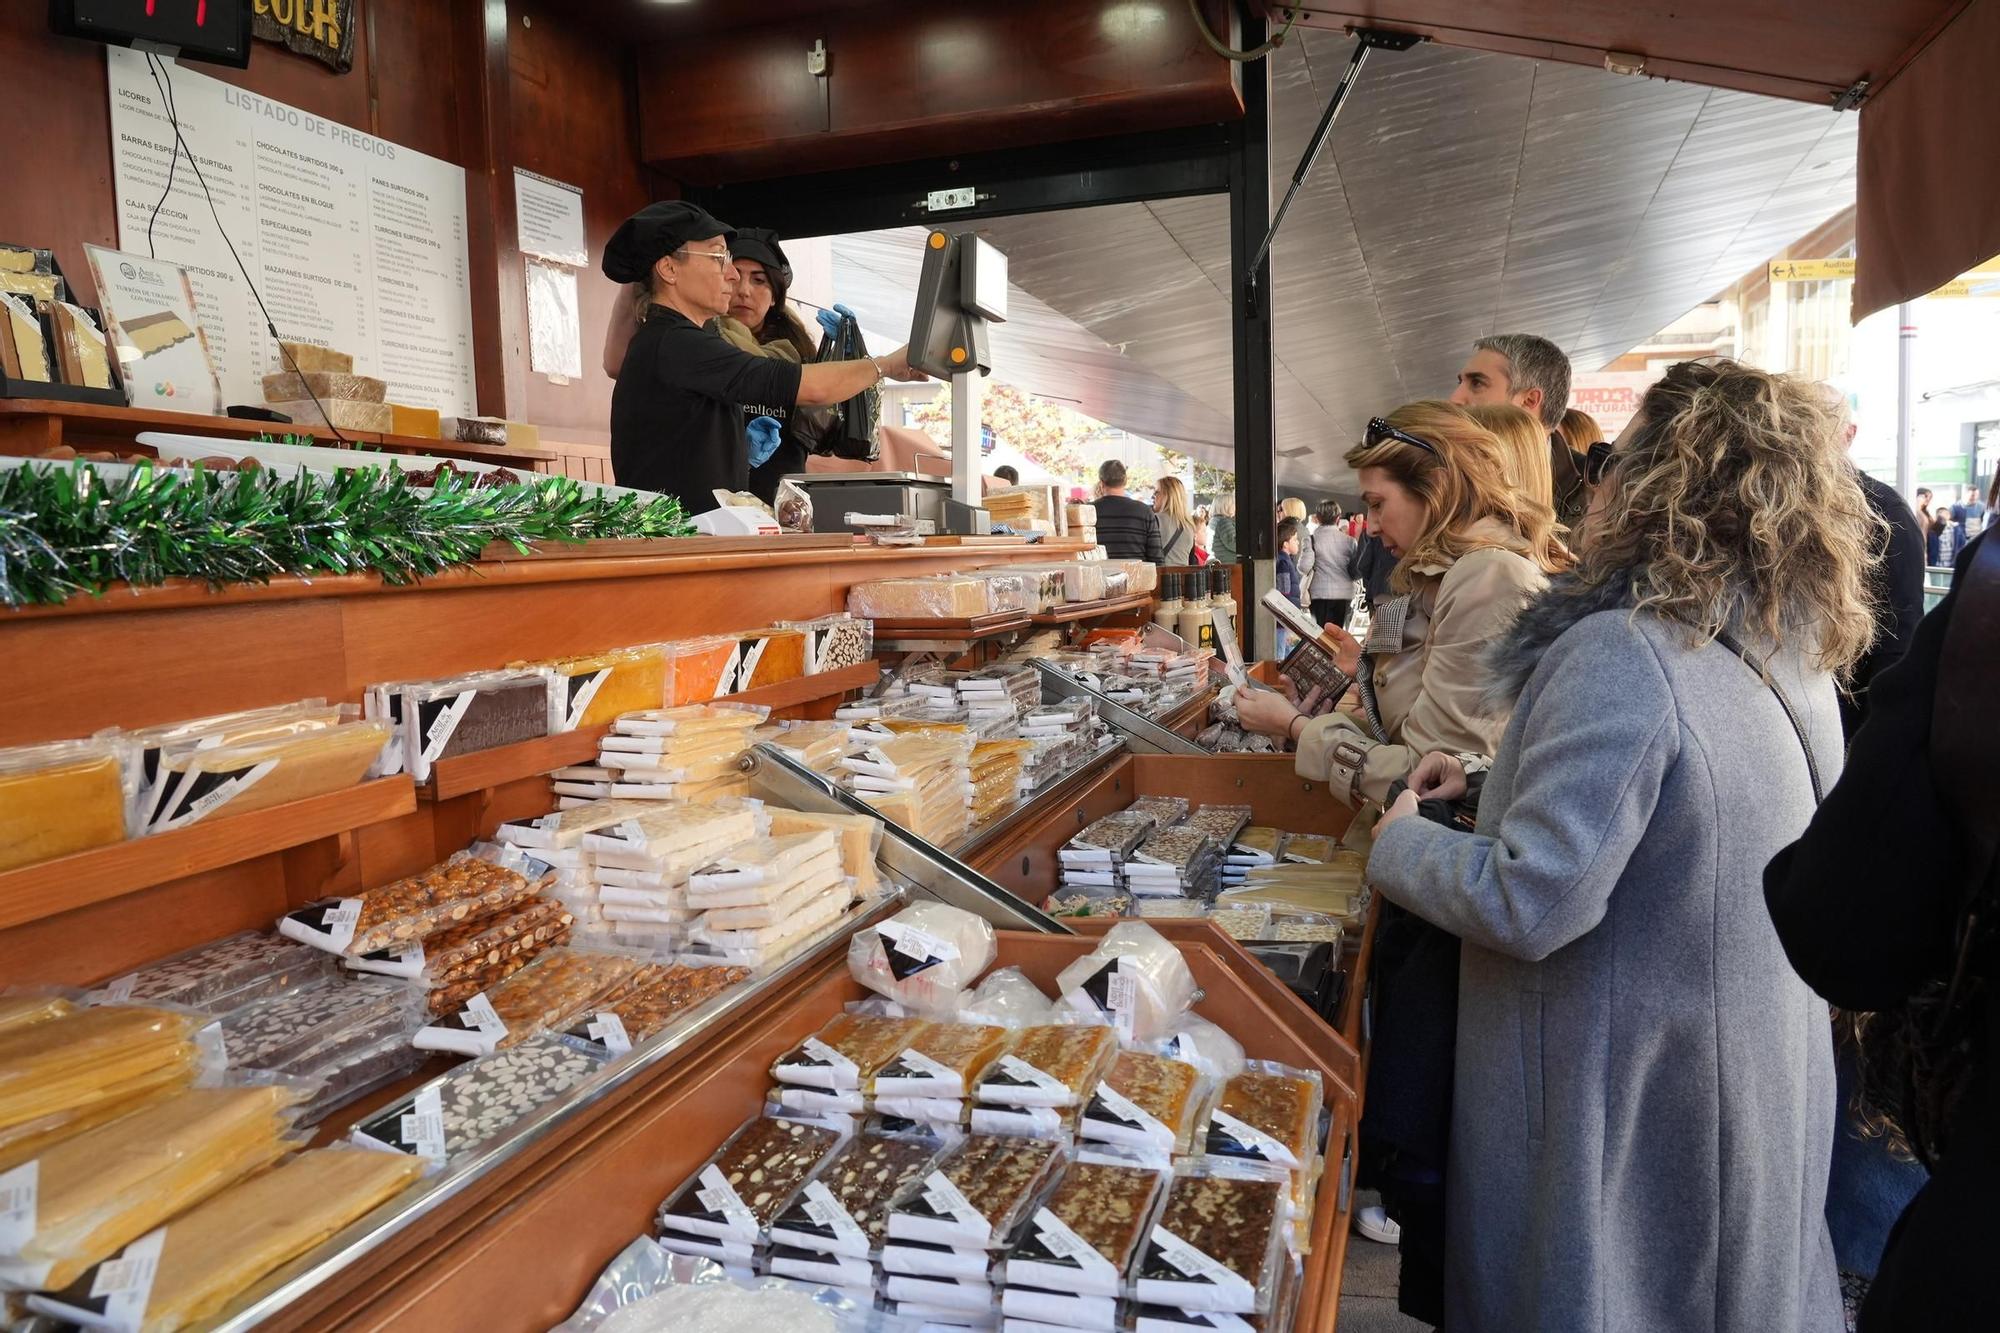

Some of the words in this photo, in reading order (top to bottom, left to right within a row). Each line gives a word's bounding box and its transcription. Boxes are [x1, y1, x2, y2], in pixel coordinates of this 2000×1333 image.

[117, 87, 151, 105] LICORES
[224, 87, 299, 128] LISTADO
[304, 115, 325, 137] DE
[330, 124, 395, 160] PRECIOS
[121, 133, 152, 149] BARRAS
[199, 156, 232, 172] SURTIDAS
[256, 139, 298, 159] CHOCOLATES
[298, 153, 328, 169] SURTIDOS
[170, 162, 195, 175] LMENDRA
[258, 181, 300, 200] CHOCOLATES
[301, 194, 309, 203] EN
[310, 197, 334, 210] BLOQUE
[371, 176, 389, 187] PANES
[390, 182, 415, 196] SURTIDOS
[125, 198, 145, 210] CAJA
[260, 217, 312, 237] ESPECIALIDADES
[374, 224, 402, 238] TURRONES
[403, 232, 427, 245] SURTIDOS
[264, 262, 301, 279] MAZAPANES
[302, 271, 331, 285] SURTIDOS
[334, 279, 341, 287] DE
[1823, 260, 1855, 269] Auditor
[216, 271, 227, 280] 200
[269, 329, 306, 343] ZAPANES
[313, 337, 328, 347] PESO
[743, 403, 787, 418] enlloch
